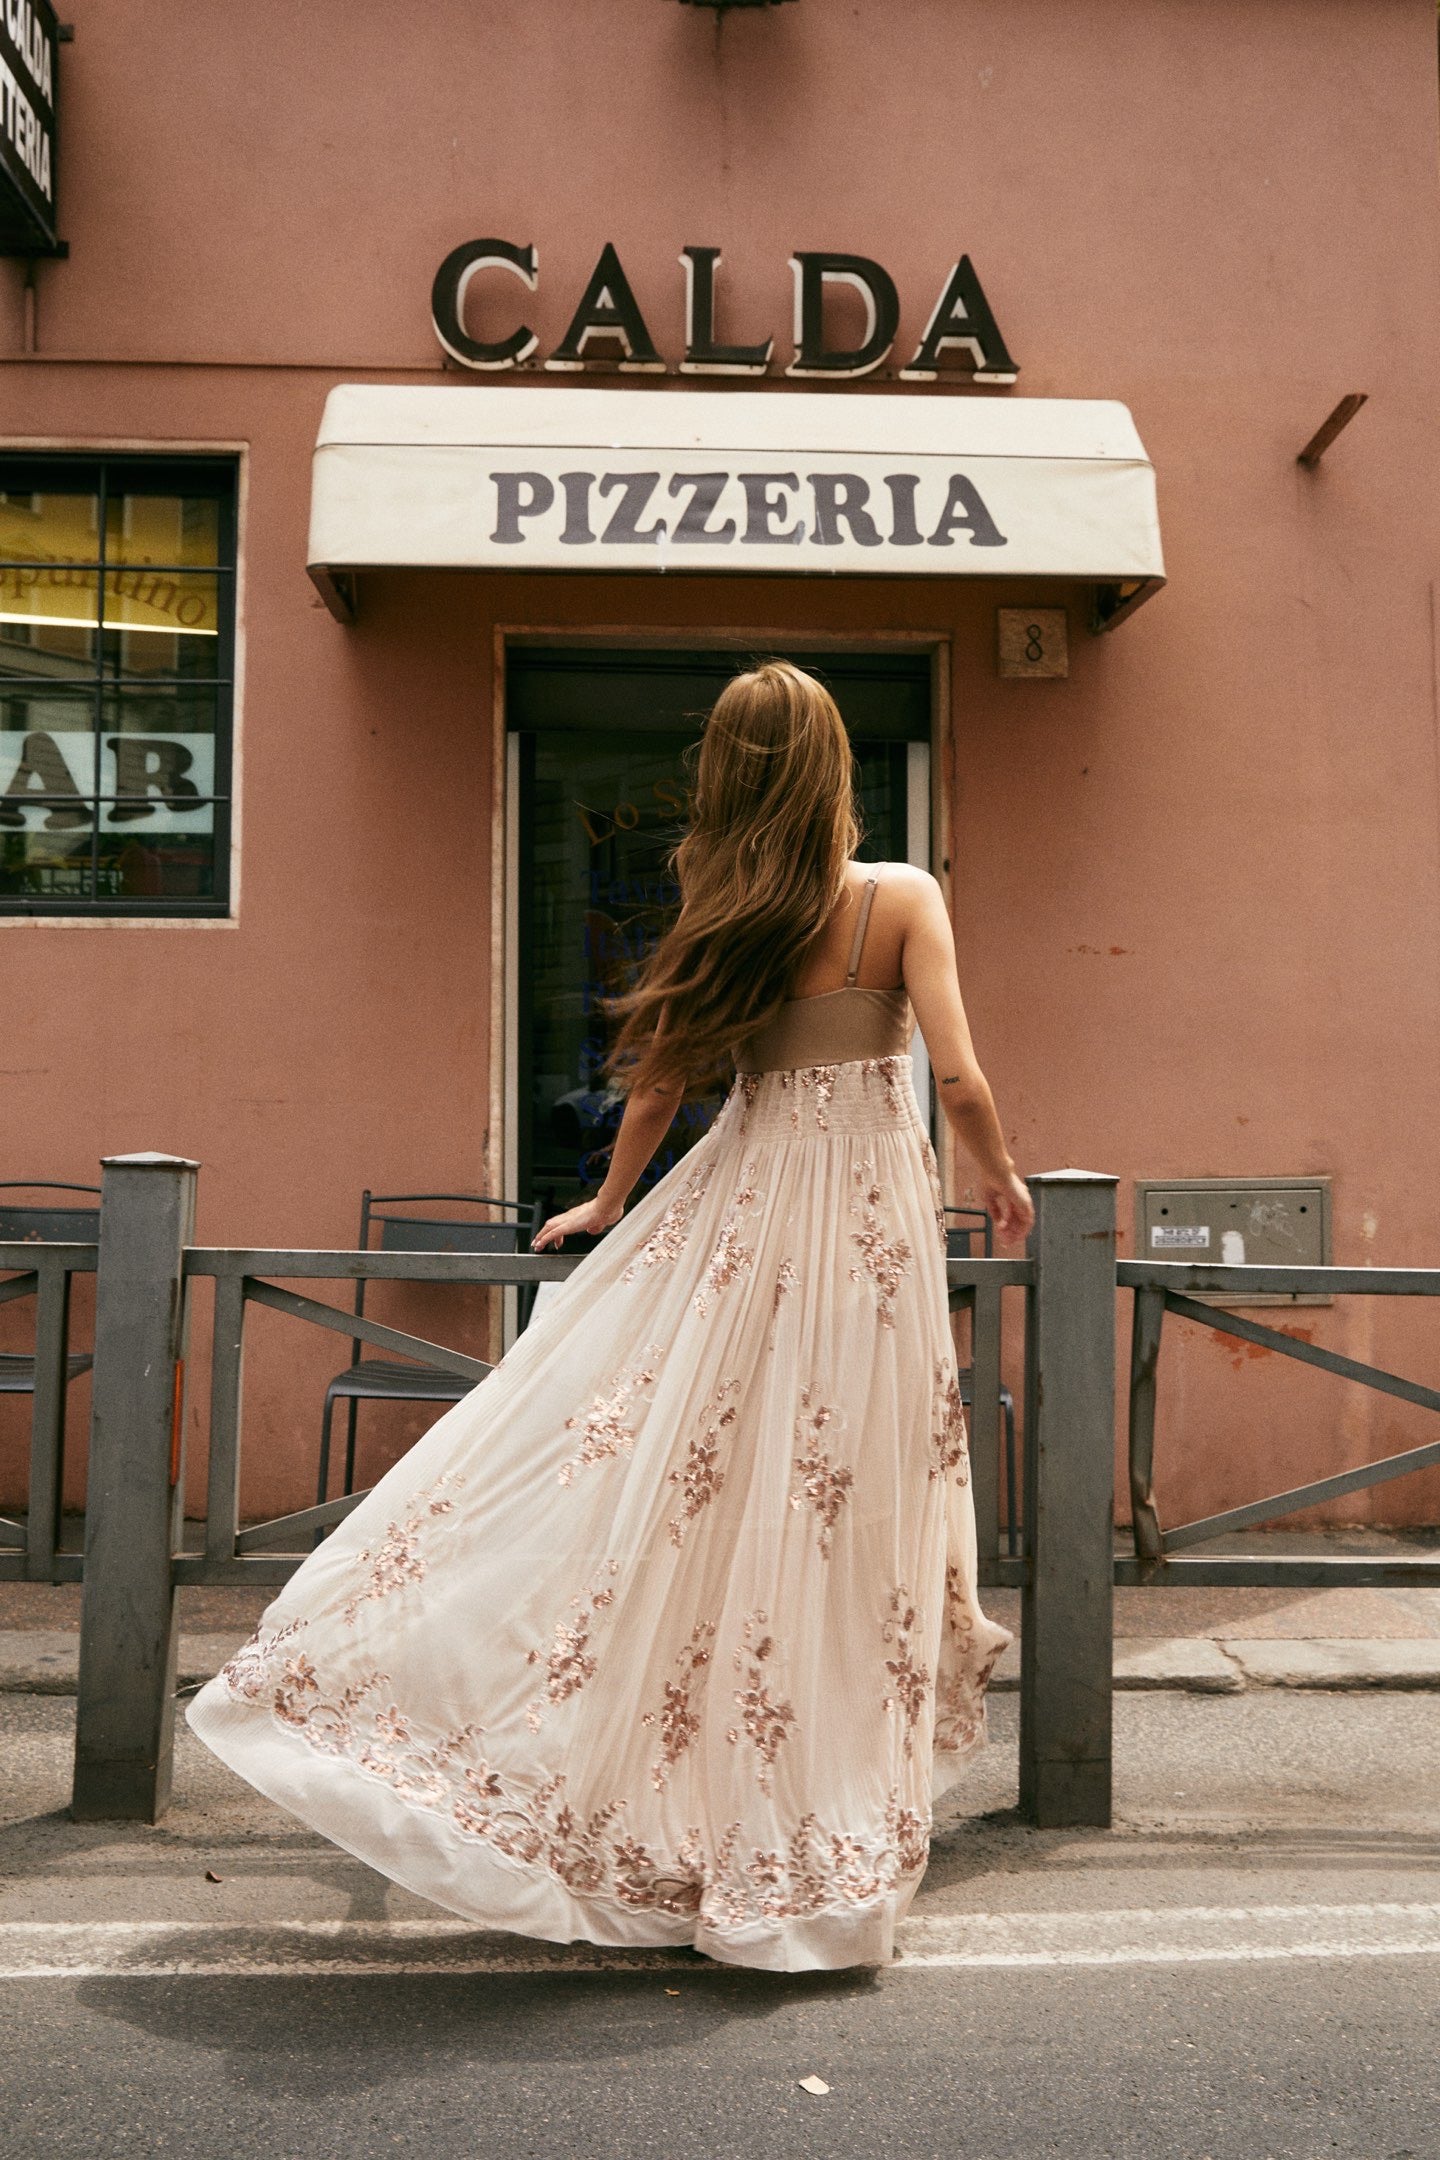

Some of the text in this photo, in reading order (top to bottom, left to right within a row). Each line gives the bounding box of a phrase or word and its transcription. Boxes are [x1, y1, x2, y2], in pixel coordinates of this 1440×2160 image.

[431, 238, 1020, 384] CALDA
[489, 471, 1008, 548] PIZZERIA
[1025, 623, 1044, 662] 8
